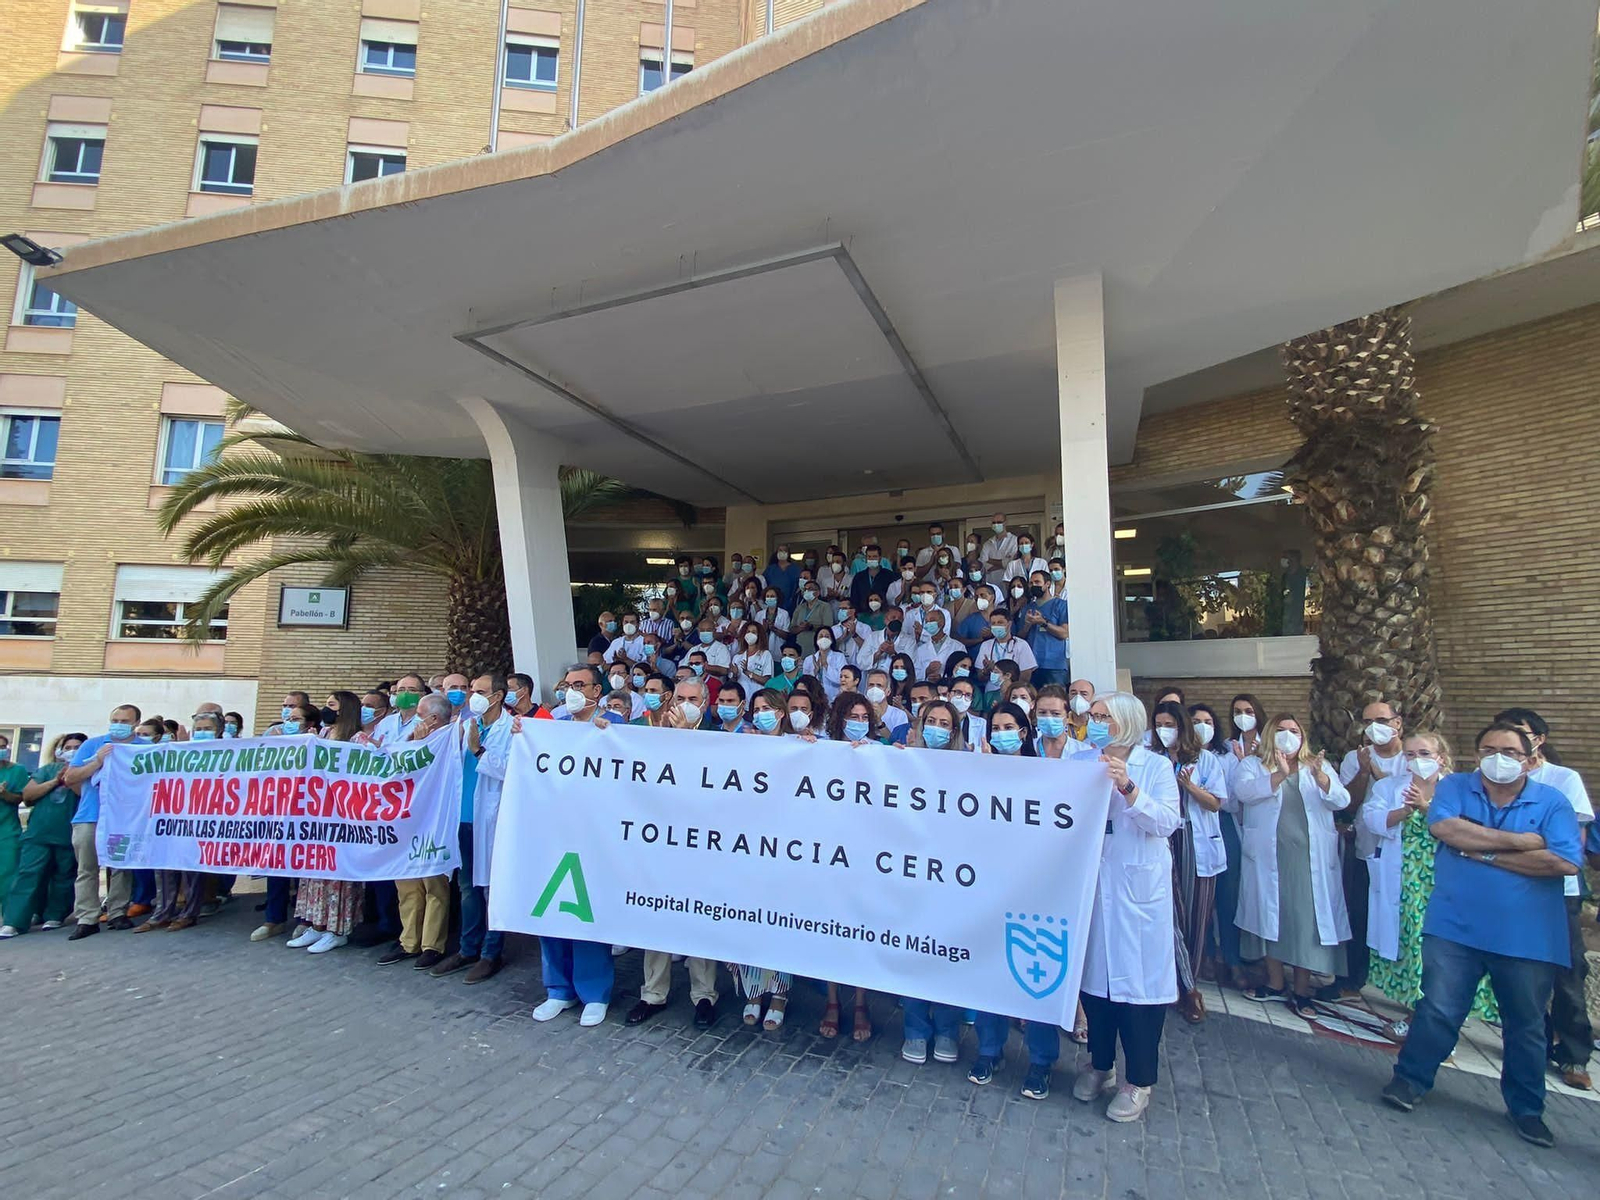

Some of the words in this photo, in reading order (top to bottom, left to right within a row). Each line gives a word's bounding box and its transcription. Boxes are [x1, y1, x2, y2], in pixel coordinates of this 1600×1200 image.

[290, 609, 323, 618] Pabellón
[329, 610, 336, 618] B
[131, 749, 234, 775] SINDICATO
[235, 744, 307, 772] MÉDICO
[313, 745, 341, 773] DE
[346, 745, 435, 778] MÁLAGA
[150, 778, 185, 818] ¡NO
[188, 774, 240, 816] MÁS
[243, 776, 415, 821] AGRESIONES!
[536, 752, 676, 785] CONTRA
[701, 766, 769, 794] LAS
[794, 775, 1074, 829] AGRESIONES
[195, 820, 216, 838] LAS
[216, 820, 284, 840] AGRESIONES
[286, 820, 296, 840] A
[198, 841, 286, 869] TOLERANCIA
[290, 843, 337, 872] CERO
[621, 820, 850, 868] TOLERANCIA
[875, 851, 976, 887] CERO
[625, 891, 689, 913] Hospital
[693, 899, 762, 924] Regional
[766, 910, 876, 943] Universitario
[880, 929, 901, 948] de
[905, 934, 971, 963] Málaga
